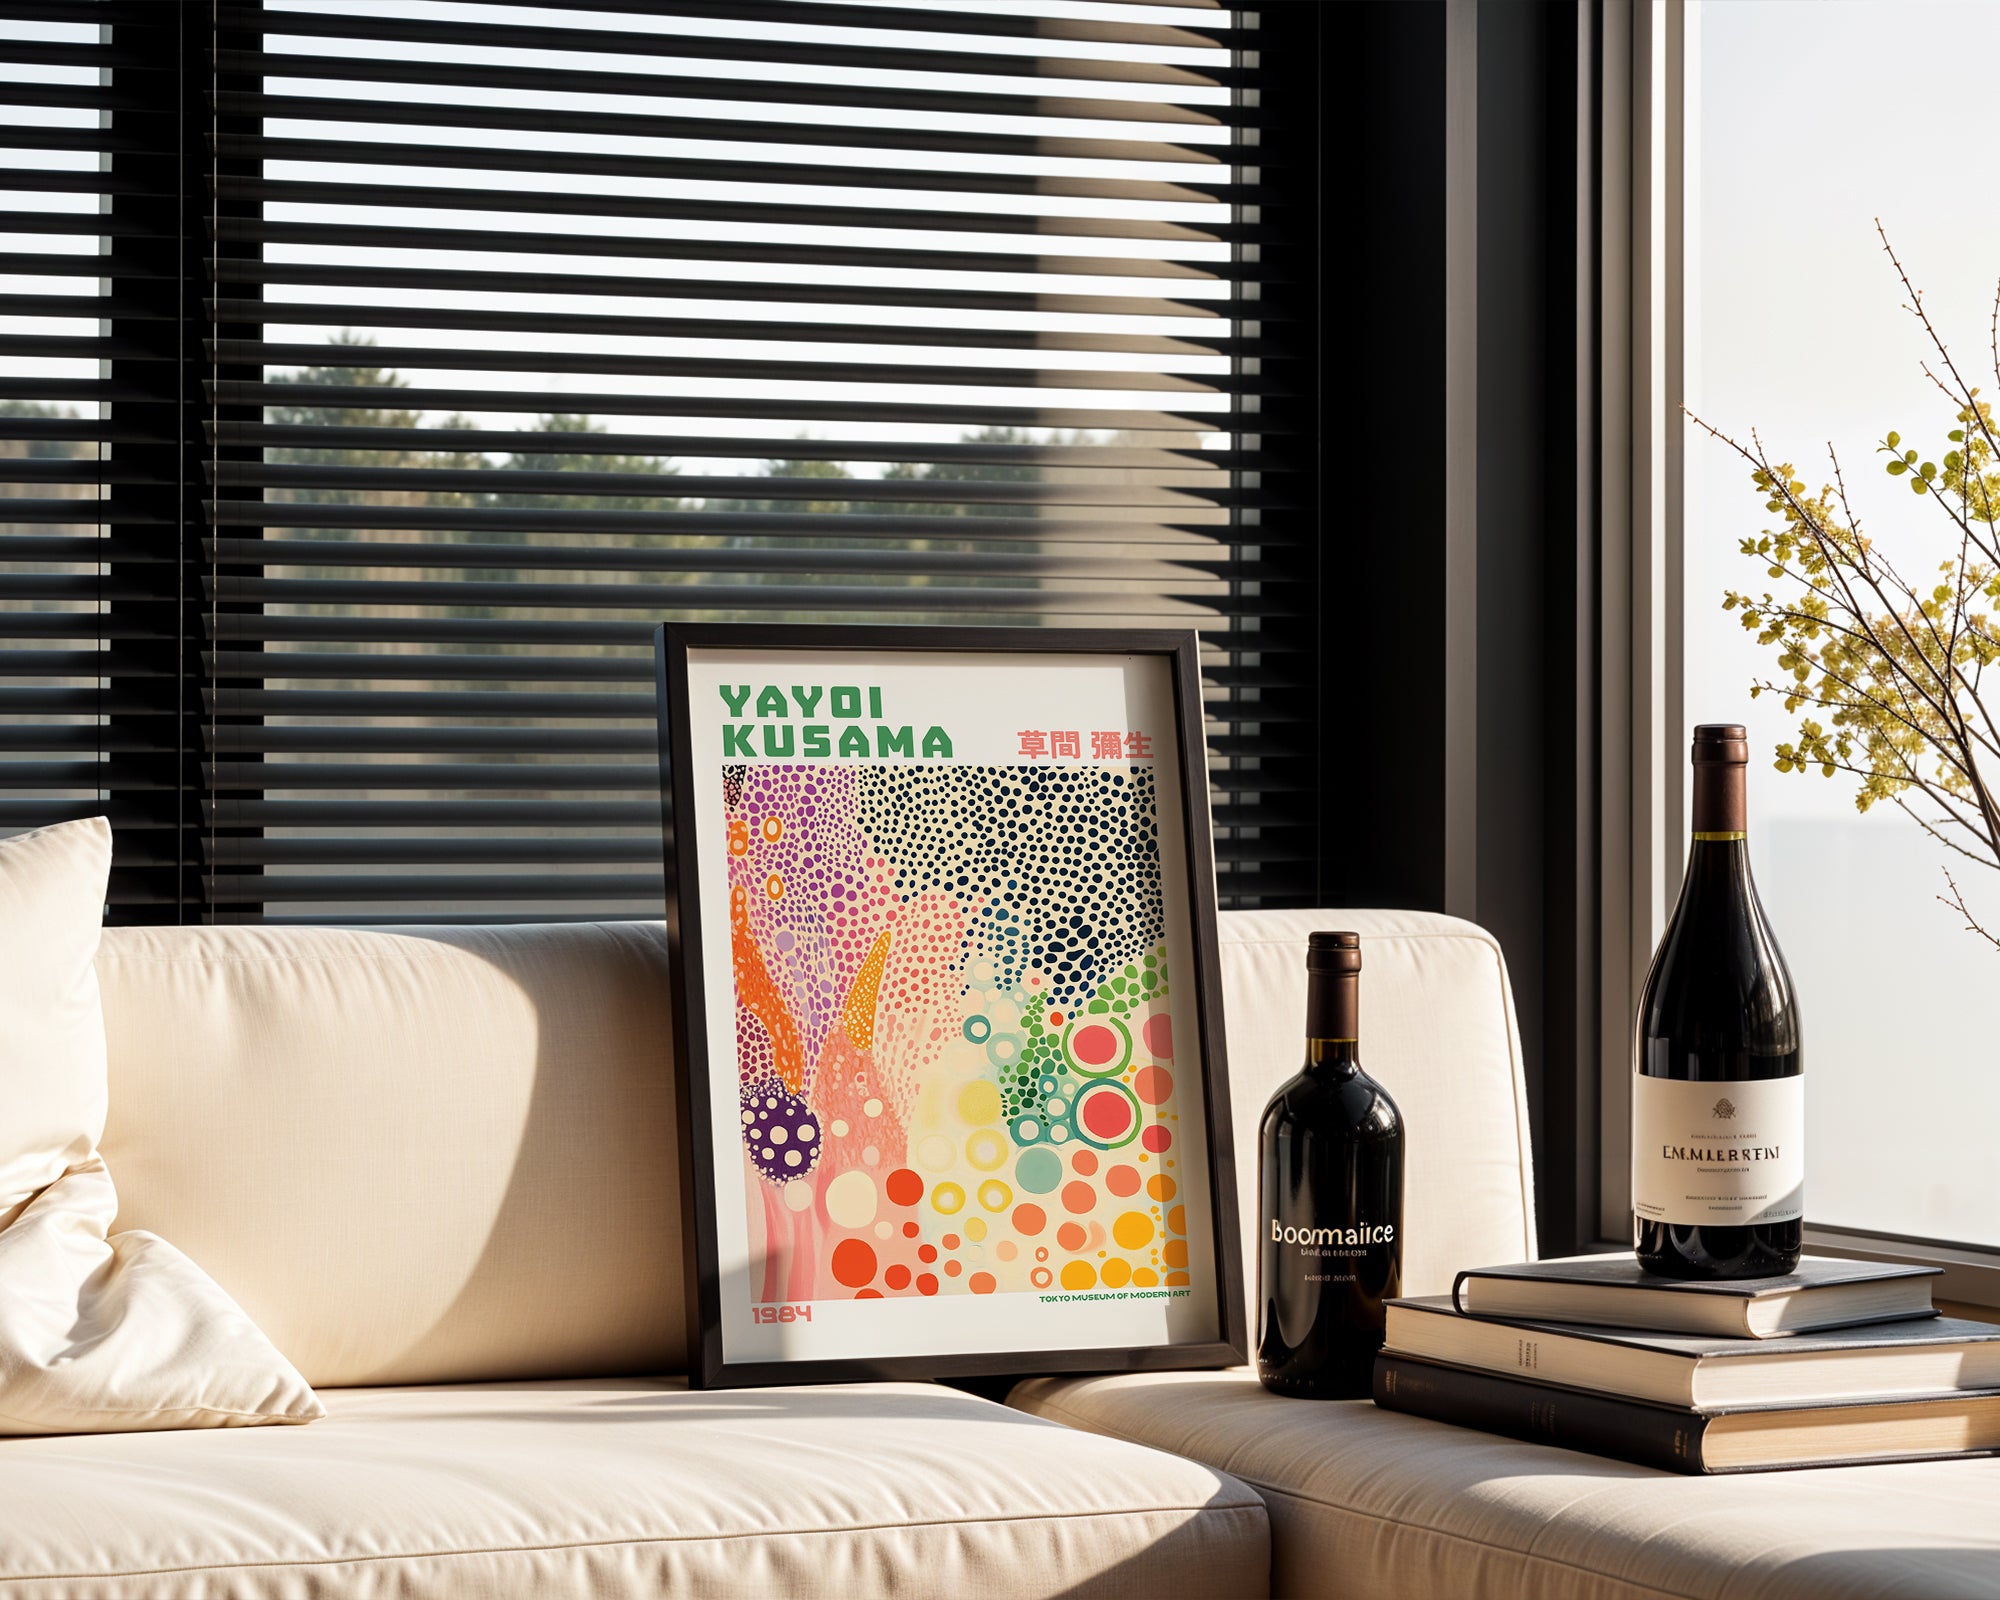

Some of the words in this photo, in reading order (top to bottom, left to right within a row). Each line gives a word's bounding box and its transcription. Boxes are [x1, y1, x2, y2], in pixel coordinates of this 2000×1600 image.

[719, 684, 883, 719] YAYOI
[722, 724, 953, 758] KUSAMA
[1017, 730, 1081, 759] 草間
[1039, 1294, 1071, 1303] TOKYO
[1072, 1292, 1116, 1302] MUSEUM
[1116, 1292, 1129, 1300] OF
[1130, 1290, 1171, 1299] MODERN
[752, 1305, 812, 1324] 1984
